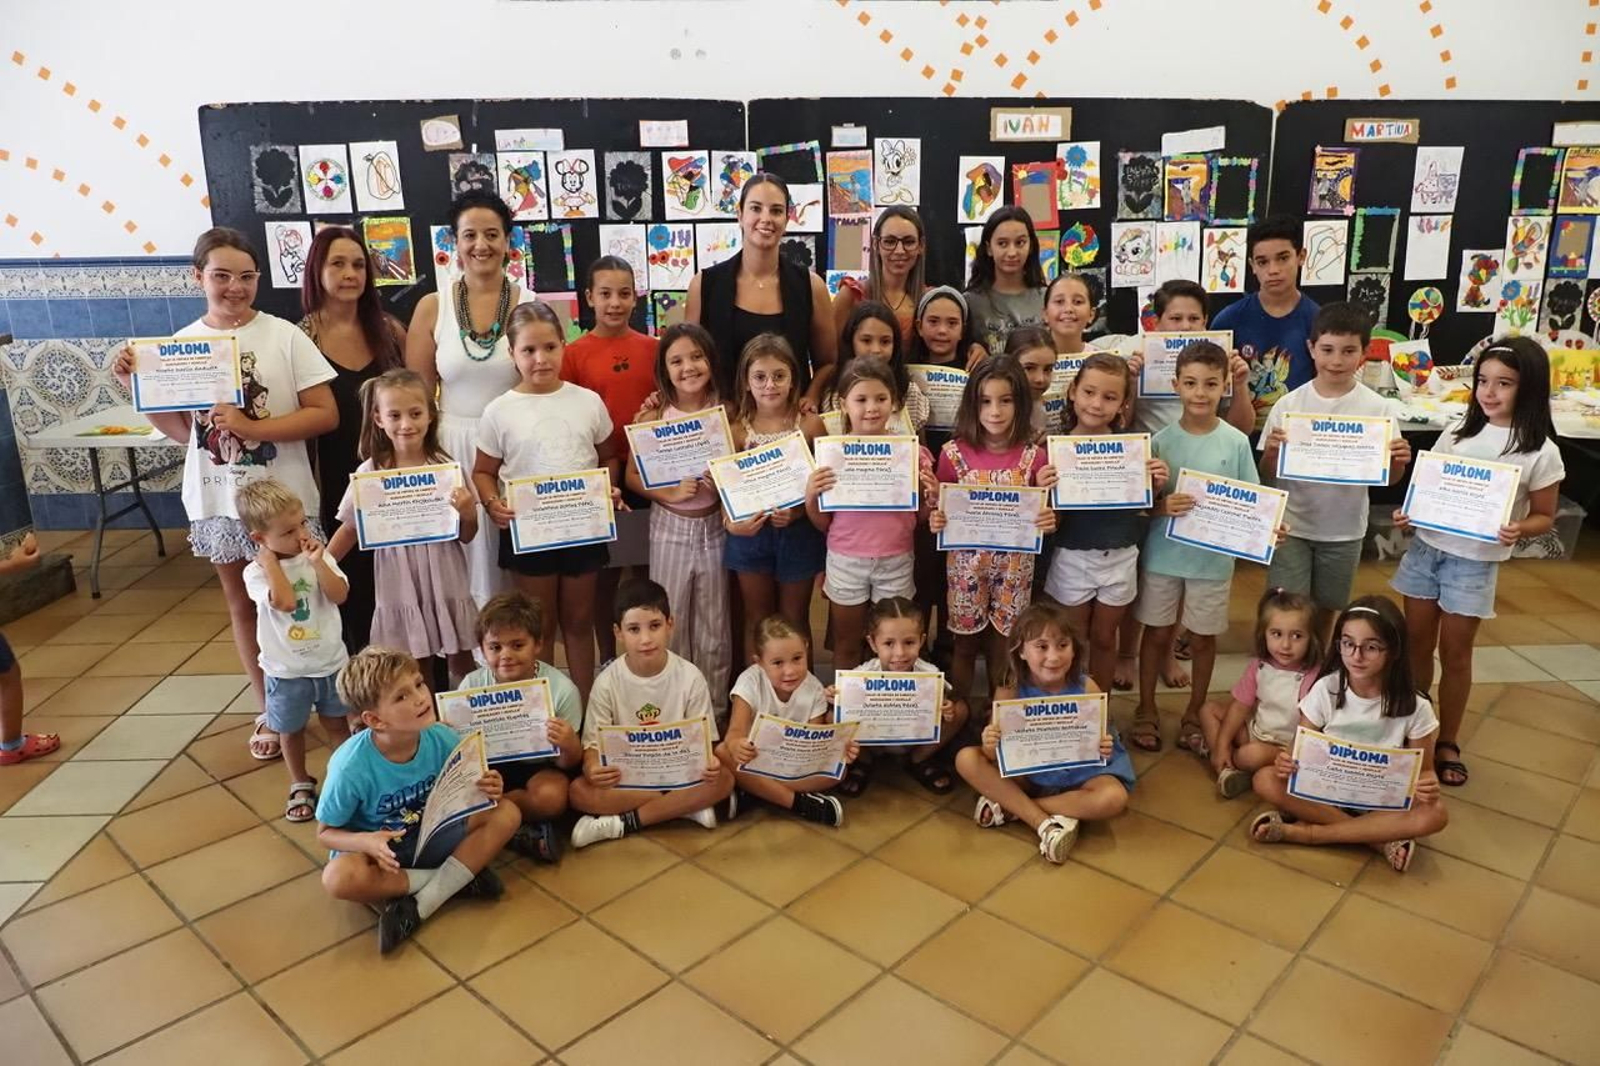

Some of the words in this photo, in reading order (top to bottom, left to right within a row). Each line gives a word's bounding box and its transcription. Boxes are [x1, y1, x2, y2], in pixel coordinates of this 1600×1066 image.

[160, 343, 211, 356] DIPLOMA
[655, 420, 702, 438] DIPLOMA
[1312, 421, 1364, 433] DIPLOMA
[844, 444, 891, 455] DIPLOMA
[1076, 442, 1124, 454] DIPLOMA
[738, 448, 784, 470] DIPLOMA
[1443, 463, 1492, 481] DIPLOMA
[383, 473, 436, 490] DIPLOMA
[536, 479, 586, 495] DIPLOMA
[970, 491, 1020, 503] DIPLOMA
[1207, 483, 1257, 504] DIPLOMA
[866, 679, 916, 691] DIPLOMA
[470, 689, 523, 708] DIPLOMA
[1025, 702, 1078, 716] DIPLOMA
[628, 729, 682, 743] DIPLOMA
[785, 727, 835, 740] DIPLOMA
[1330, 745, 1388, 765] DIPLOMA
[376, 774, 436, 815] SONIC
